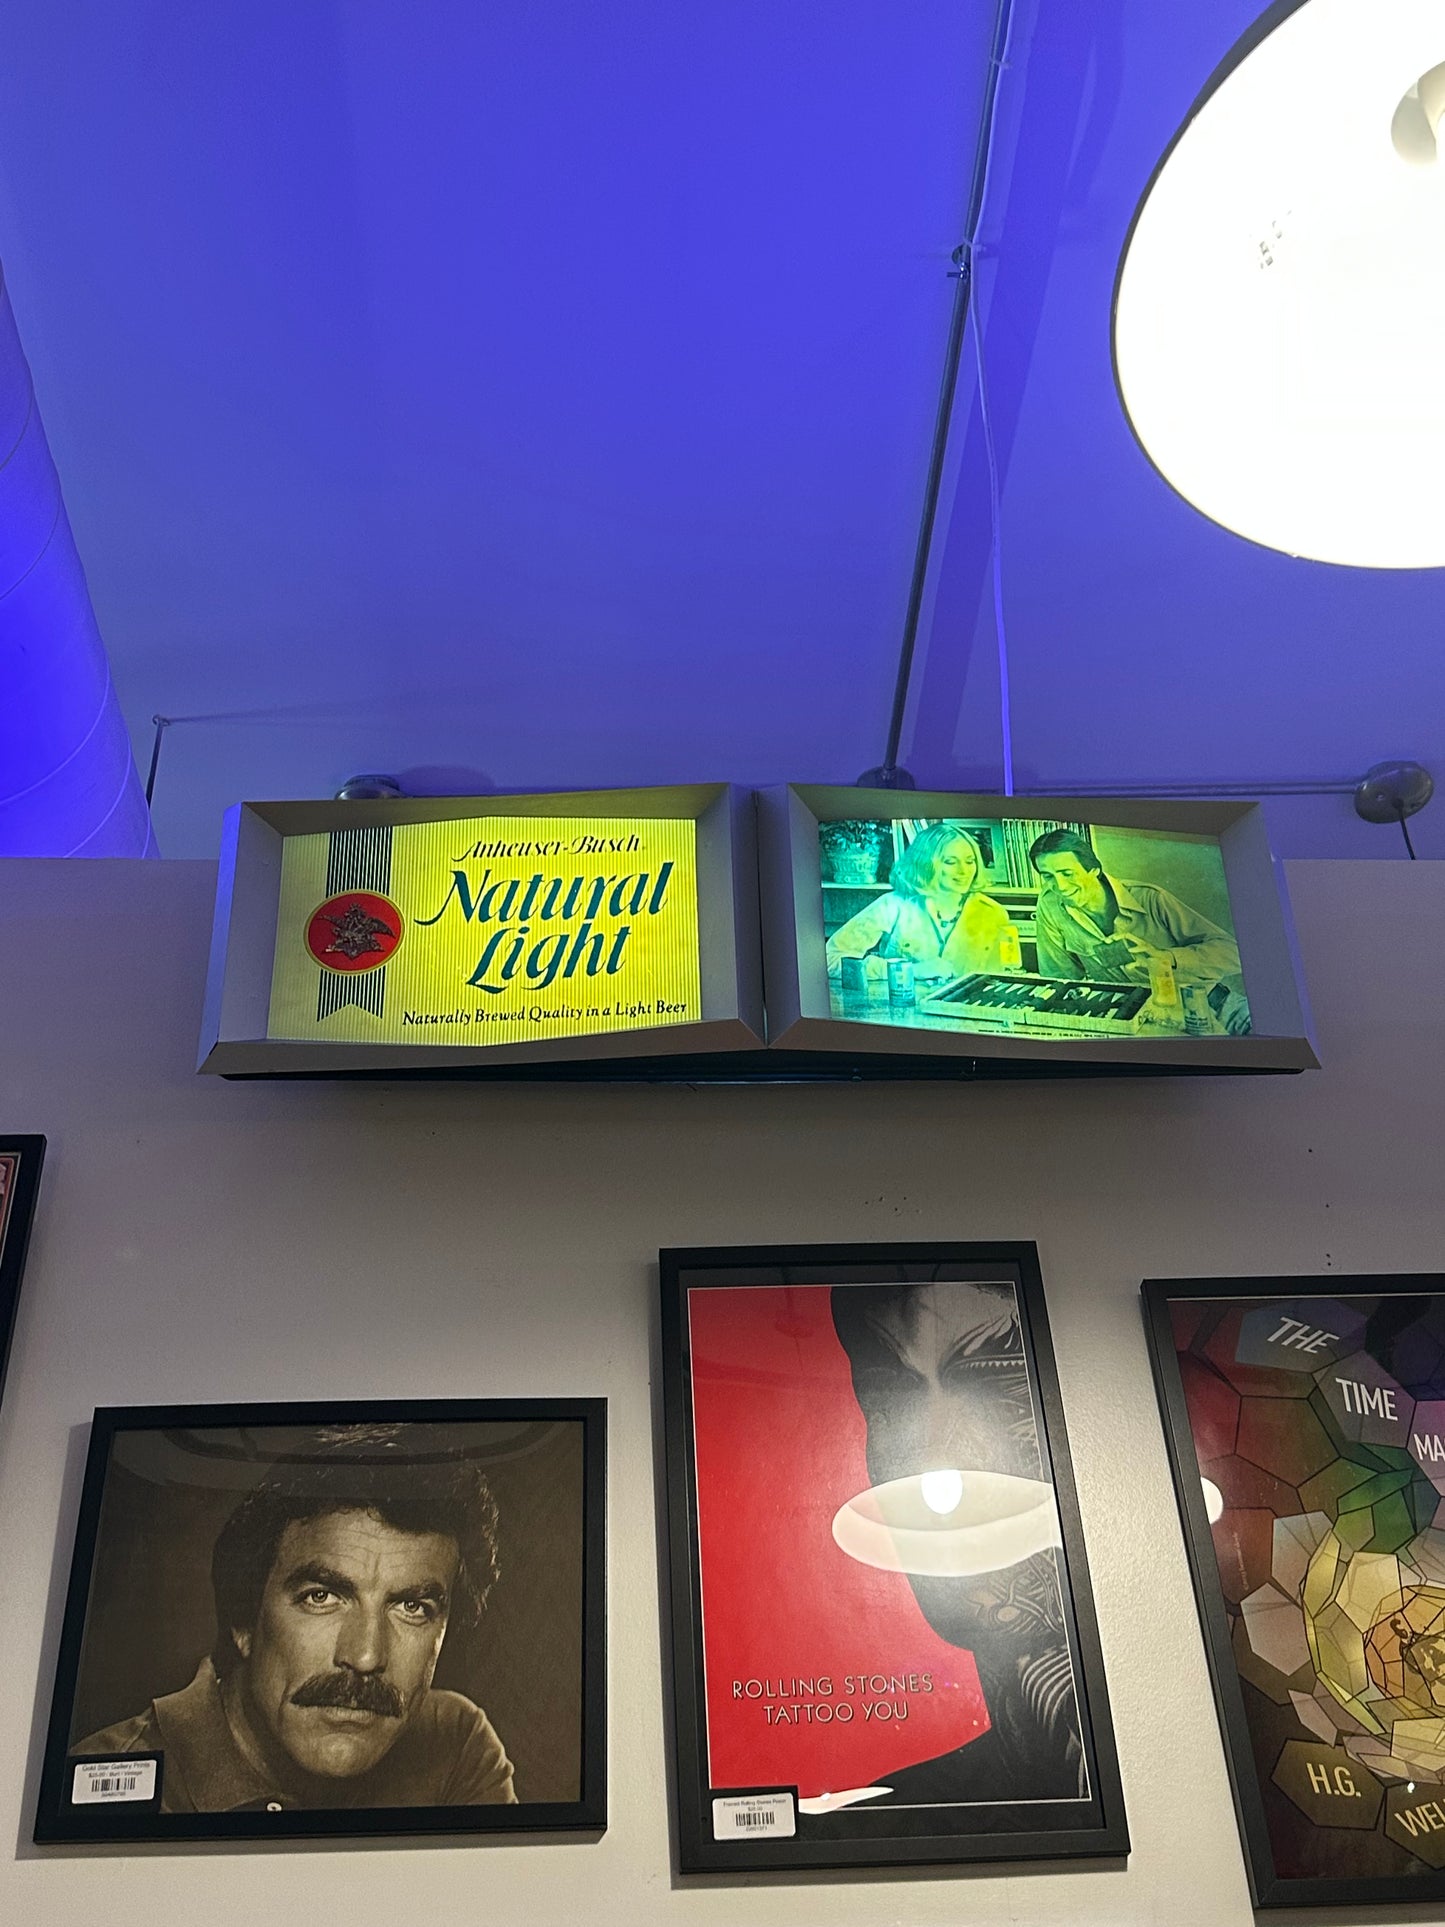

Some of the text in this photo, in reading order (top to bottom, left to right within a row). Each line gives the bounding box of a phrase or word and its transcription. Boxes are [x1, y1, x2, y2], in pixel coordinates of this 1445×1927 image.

[451, 834, 640, 862] Anheuser-Busch
[414, 861, 674, 925] Natural
[466, 922, 632, 994] Light
[402, 999, 687, 1026] Naturally Brewed Quality in a Light Beer
[1266, 1316, 1340, 1354] THE
[1335, 1377, 1399, 1422] TIME
[732, 1672, 934, 1699] ROLLING STONES
[763, 1700, 909, 1725] TATTOO YOU
[1306, 1762, 1361, 1797] H.G.
[1394, 1798, 1445, 1837] WEL
